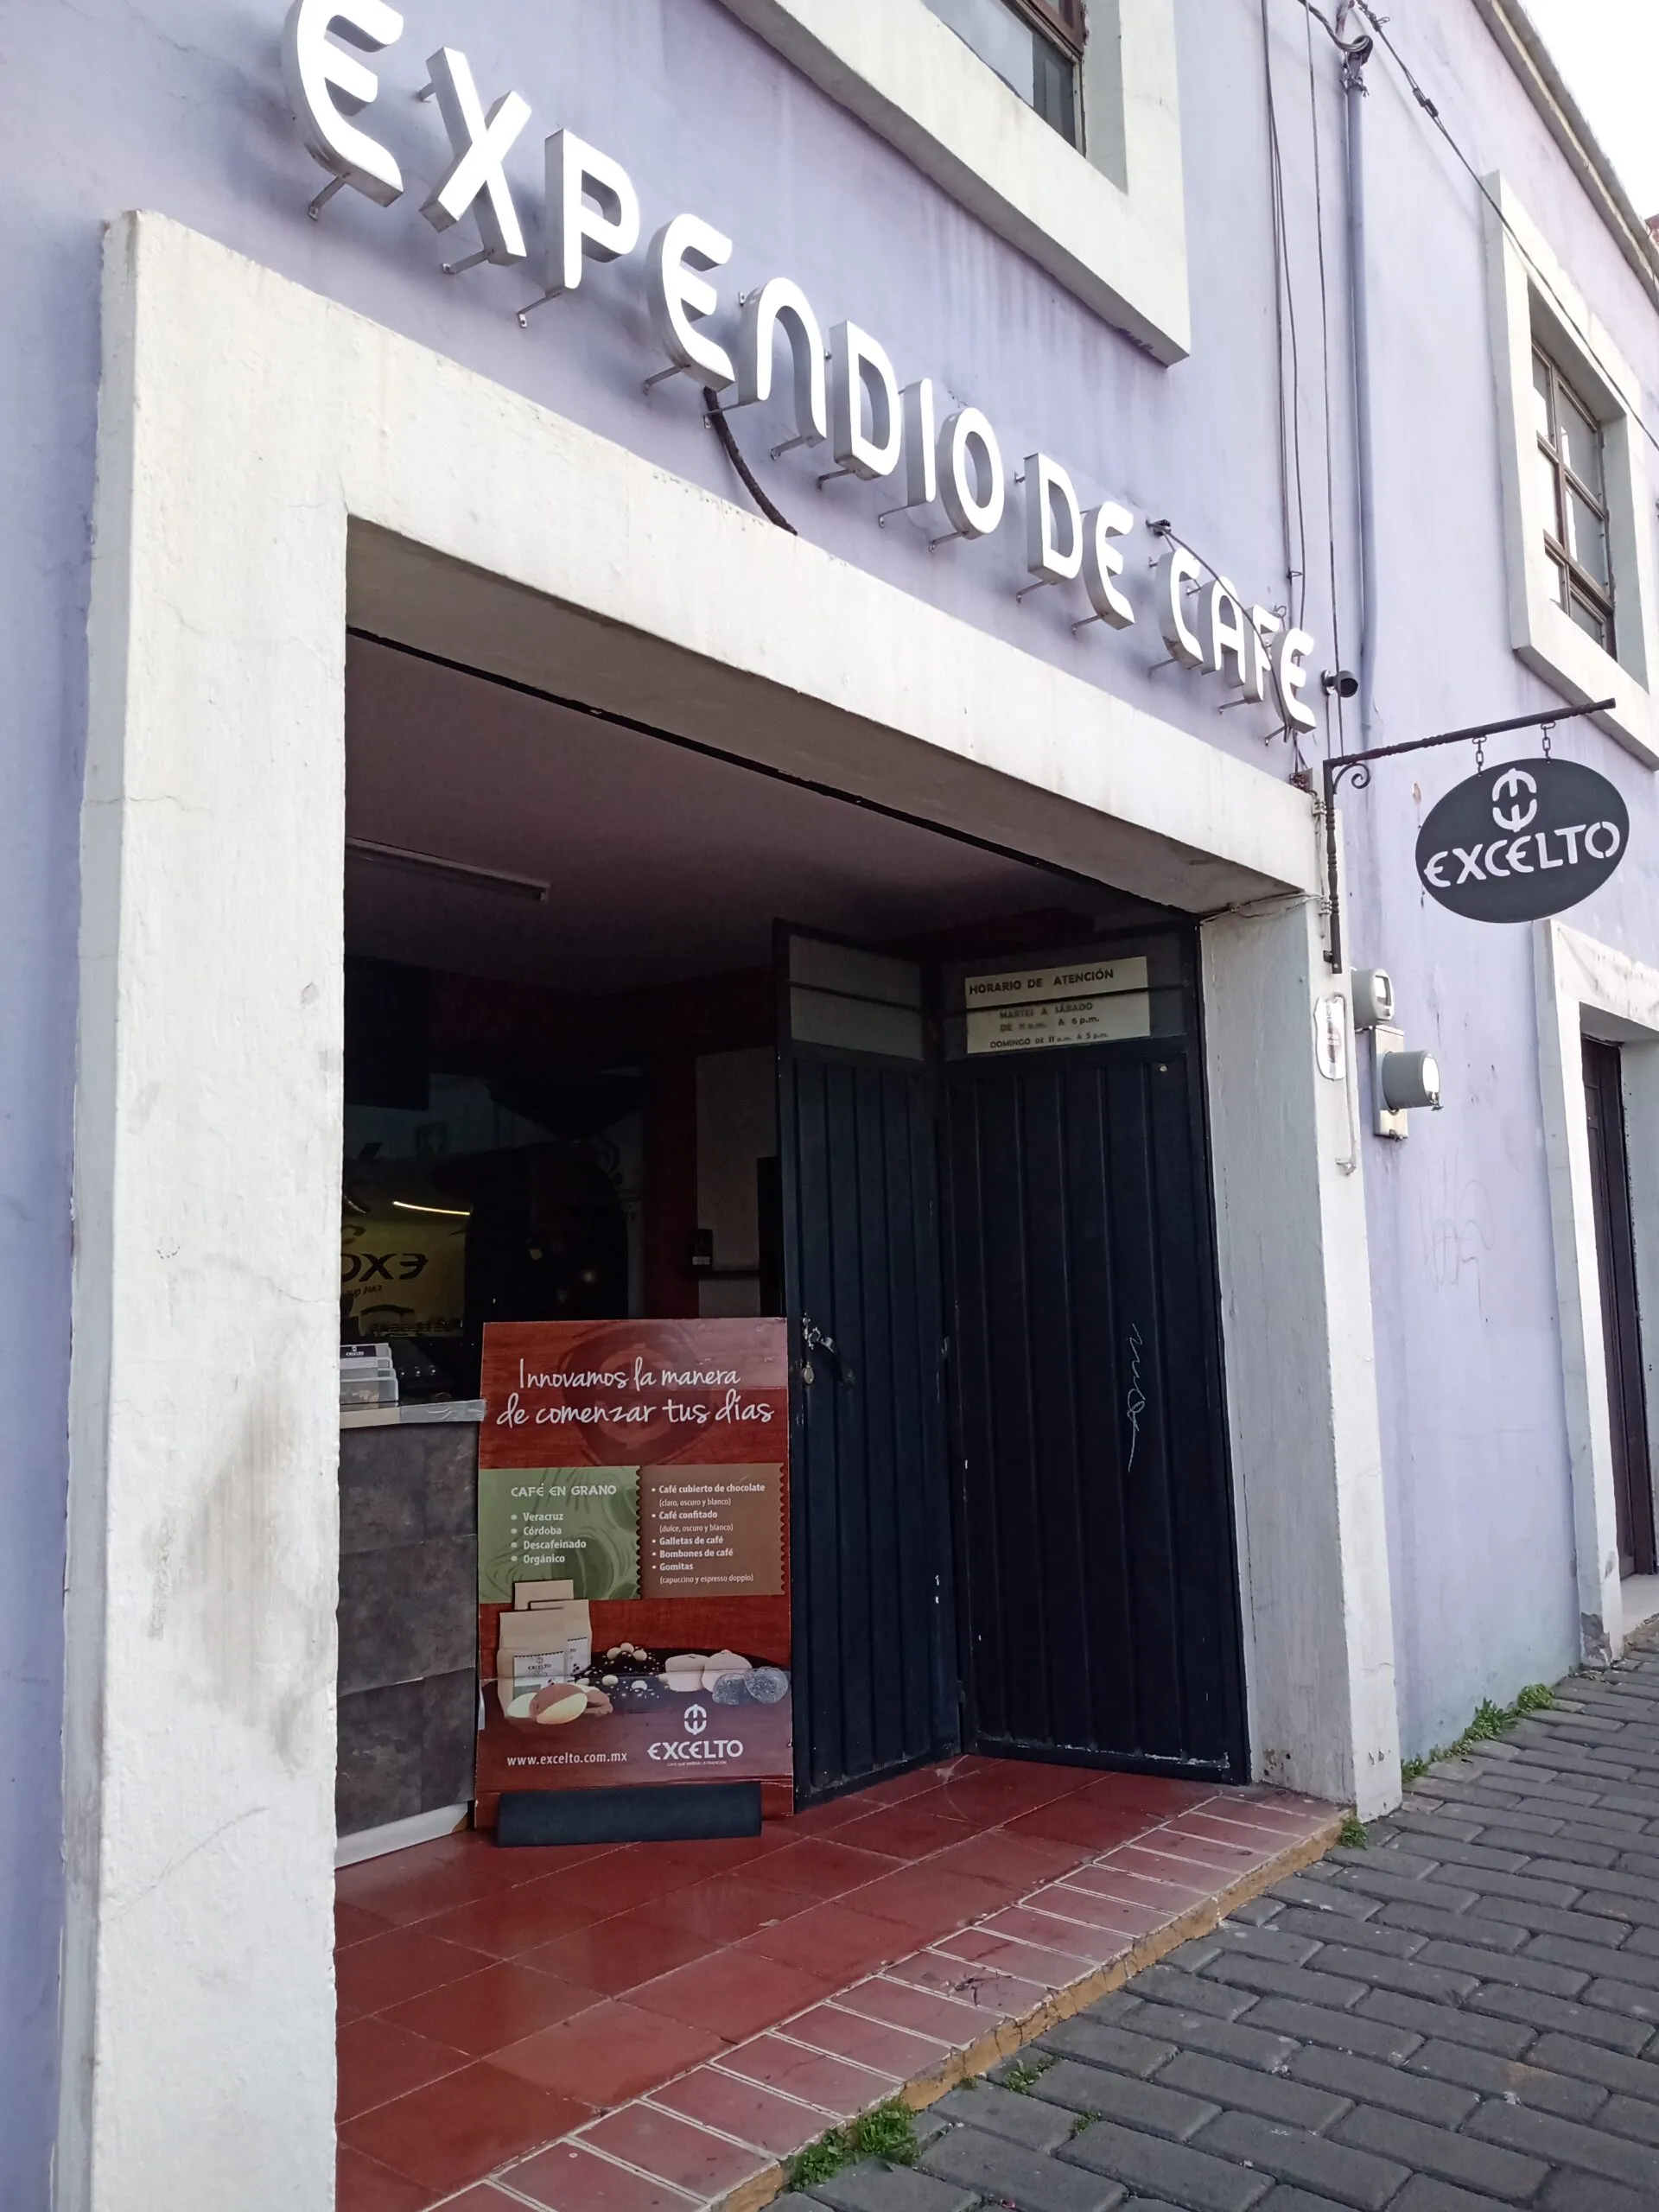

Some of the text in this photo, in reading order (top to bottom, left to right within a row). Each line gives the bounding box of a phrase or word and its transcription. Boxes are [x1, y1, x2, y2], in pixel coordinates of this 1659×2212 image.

[294, 0, 1004, 537] EXPENDIO
[1026, 453, 1135, 629] DE
[1423, 821, 1621, 888] EXCELTO
[969, 969, 1115, 995] HORARIO DE ATENCIÓN
[1040, 1007, 1049, 1016] A
[1054, 1001, 1094, 1014] SÁBADO
[1000, 1022, 1013, 1032] DE
[1058, 1018, 1065, 1027] A
[1079, 1015, 1100, 1026] p.m.
[989, 1038, 1032, 1049] DOMINGO
[518, 1357, 741, 1391] Innovamos la manera
[496, 1388, 775, 1428] de comenzar tus días
[511, 1483, 617, 1497] CAFÉ EN GRANO
[658, 1483, 766, 1494] Café cubierto de chocolate
[659, 1498, 678, 1507] (claro,
[707, 1497, 731, 1507] blanco)
[523, 1511, 564, 1522] Veracruz
[658, 1510, 718, 1520] Café confitado
[523, 1526, 562, 1535] Córdoba
[659, 1524, 682, 1533] (dulce,
[709, 1523, 734, 1533] blanco)
[523, 1539, 587, 1550] Descafeinado
[659, 1535, 724, 1546] Galletas de café
[659, 1548, 734, 1559] Bombones de café
[523, 1554, 566, 1566] Orgánico
[659, 1562, 694, 1572] Gomitas
[659, 1576, 695, 1585] (capuccino
[728, 1573, 753, 1583] doppio)
[646, 1739, 744, 1760] EXCELTO
[506, 1751, 628, 1768] www.excelto.com.mx
